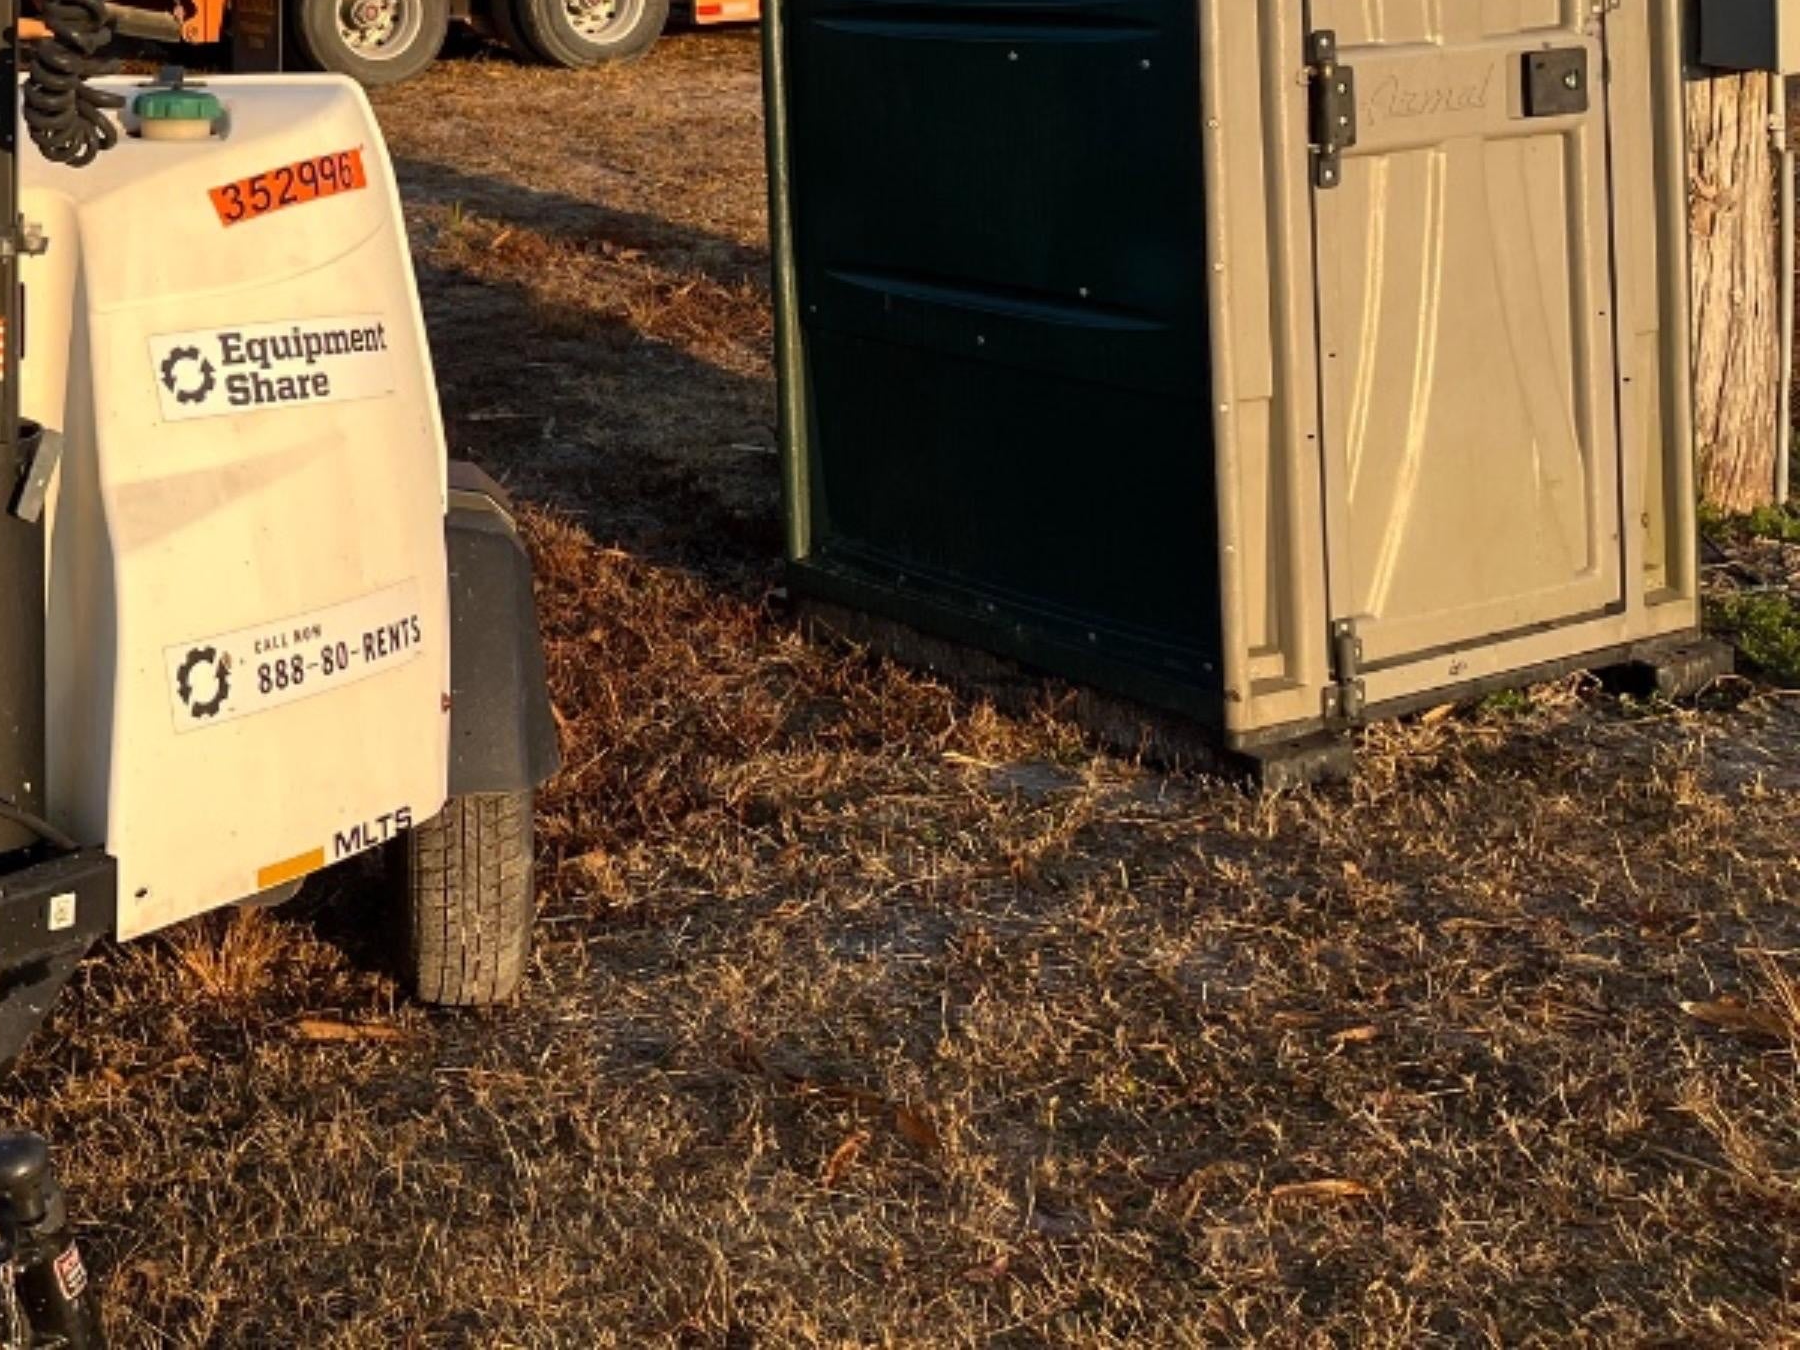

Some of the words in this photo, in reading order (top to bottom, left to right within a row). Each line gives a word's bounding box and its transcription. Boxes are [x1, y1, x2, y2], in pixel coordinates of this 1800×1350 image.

[220, 151, 353, 222] 352996
[218, 322, 388, 369] Equipment
[225, 371, 331, 406] Share
[254, 634, 289, 655] CALL
[257, 614, 422, 695] 888-80-RENTS
[334, 806, 413, 858] MLTS
